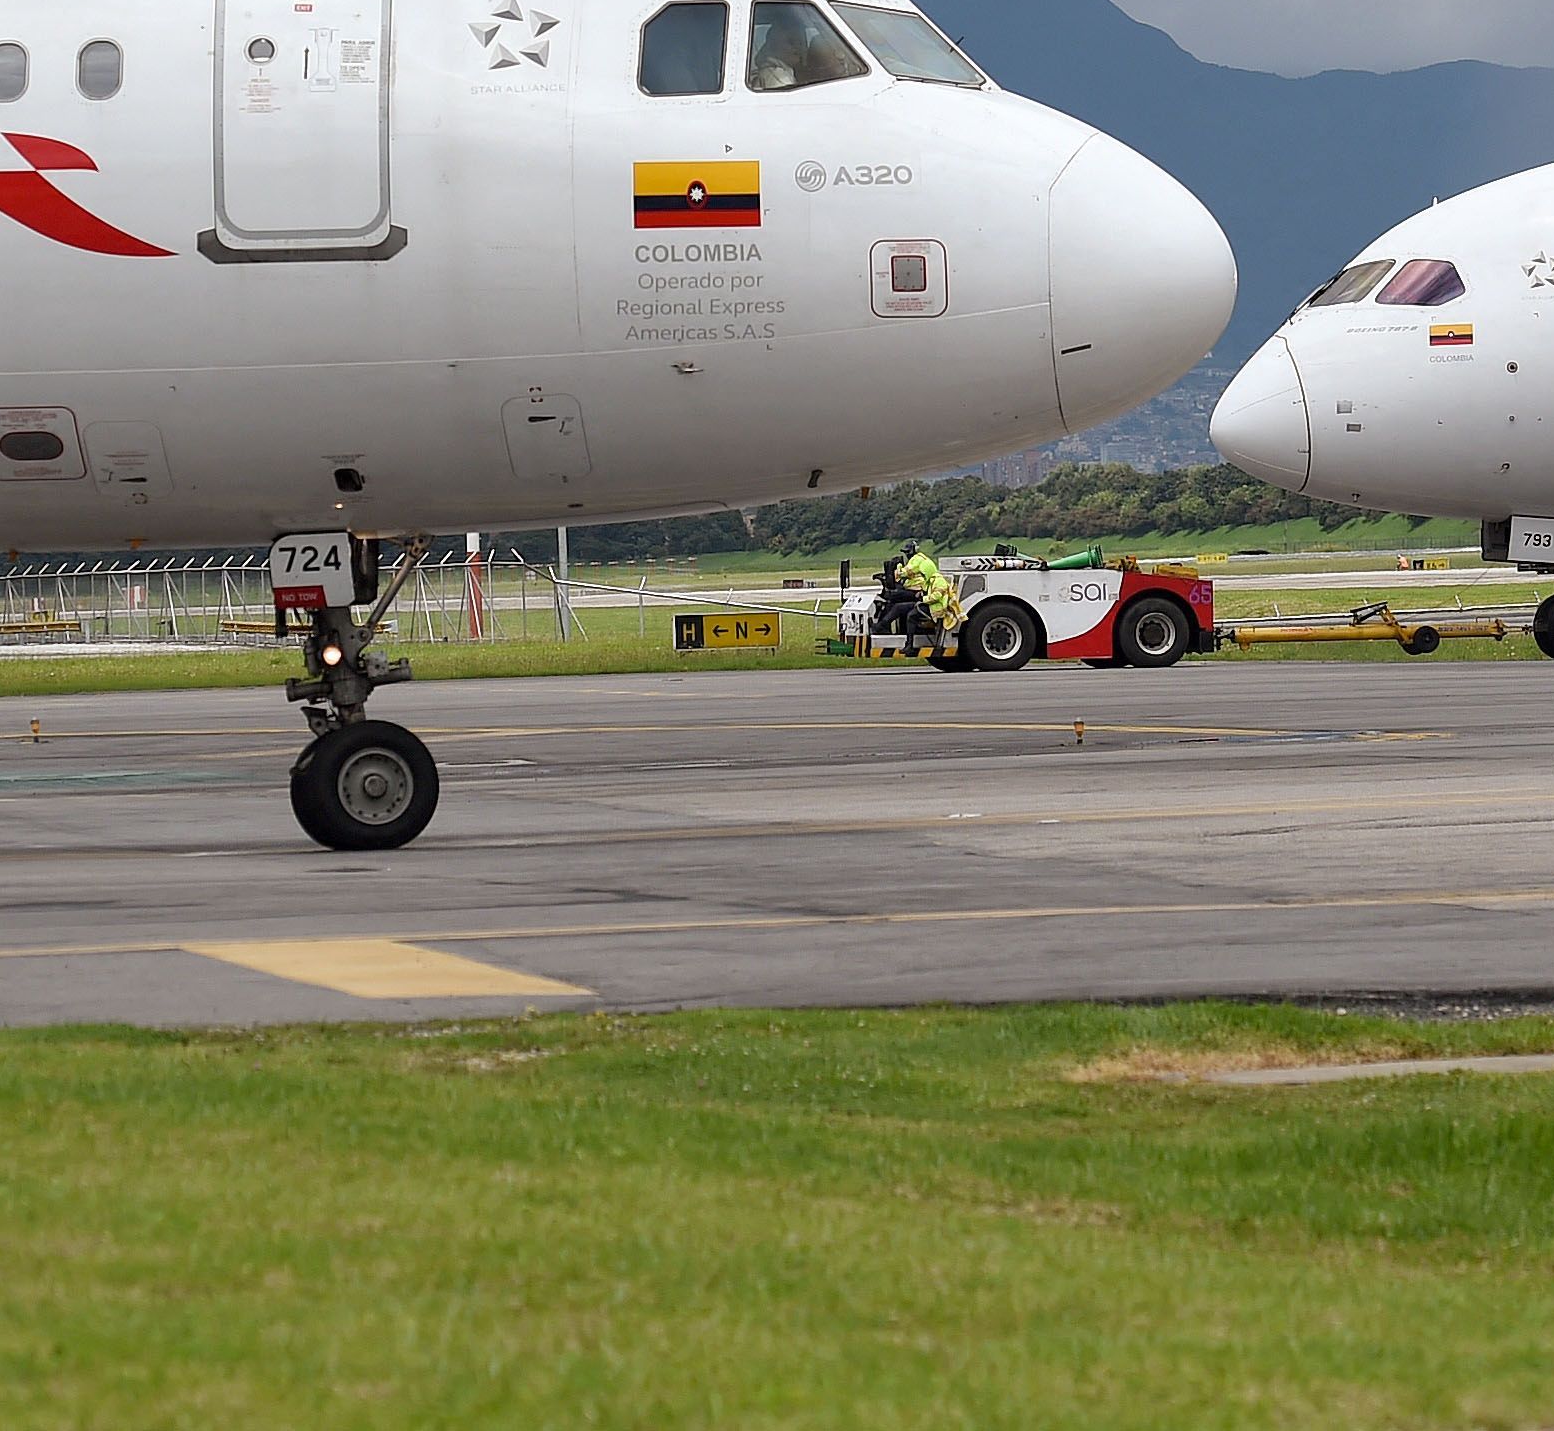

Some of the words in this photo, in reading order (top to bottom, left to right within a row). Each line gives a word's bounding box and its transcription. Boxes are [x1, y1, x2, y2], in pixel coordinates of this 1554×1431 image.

[470, 85, 502, 95] STAR
[506, 82, 567, 93] ALLIANCE
[833, 165, 912, 185] A320
[634, 243, 763, 263] COLOMBIA
[637, 272, 725, 293] Operado
[730, 275, 764, 292] por
[616, 298, 704, 319] Regional
[709, 298, 786, 318] Express
[625, 324, 718, 341] Americas
[722, 322, 776, 340] S.A.S
[1429, 354, 1474, 363] COLOMBIA
[1523, 532, 1552, 548] 793
[278, 544, 342, 573] 724
[281, 594, 296, 602] NO
[298, 592, 318, 601] TOW
[1189, 583, 1212, 604] 65
[682, 623, 696, 642] H
[735, 621, 748, 640] N
